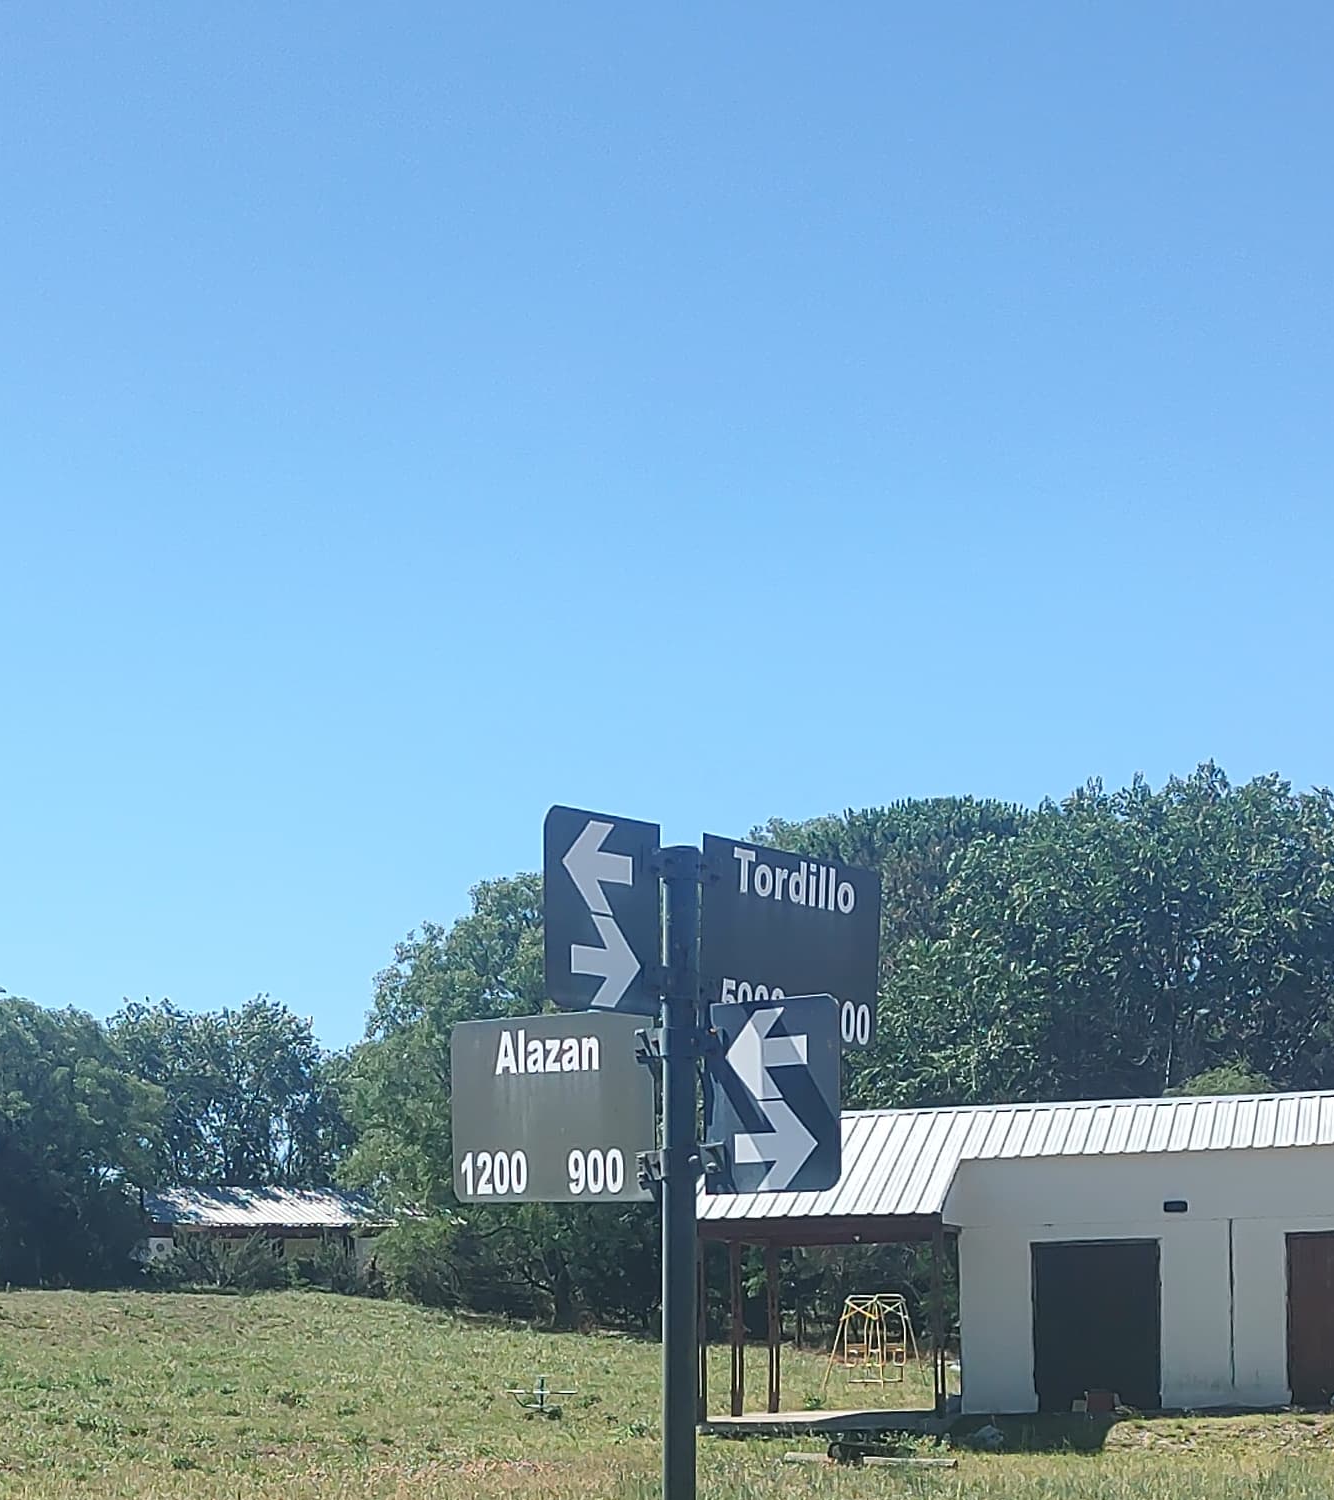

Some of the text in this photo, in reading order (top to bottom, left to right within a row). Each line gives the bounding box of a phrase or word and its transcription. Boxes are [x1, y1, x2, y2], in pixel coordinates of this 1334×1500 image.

[733, 846, 856, 915] Tordillo
[494, 1028, 601, 1076] Alazan
[460, 1147, 625, 1197] 1200 900
